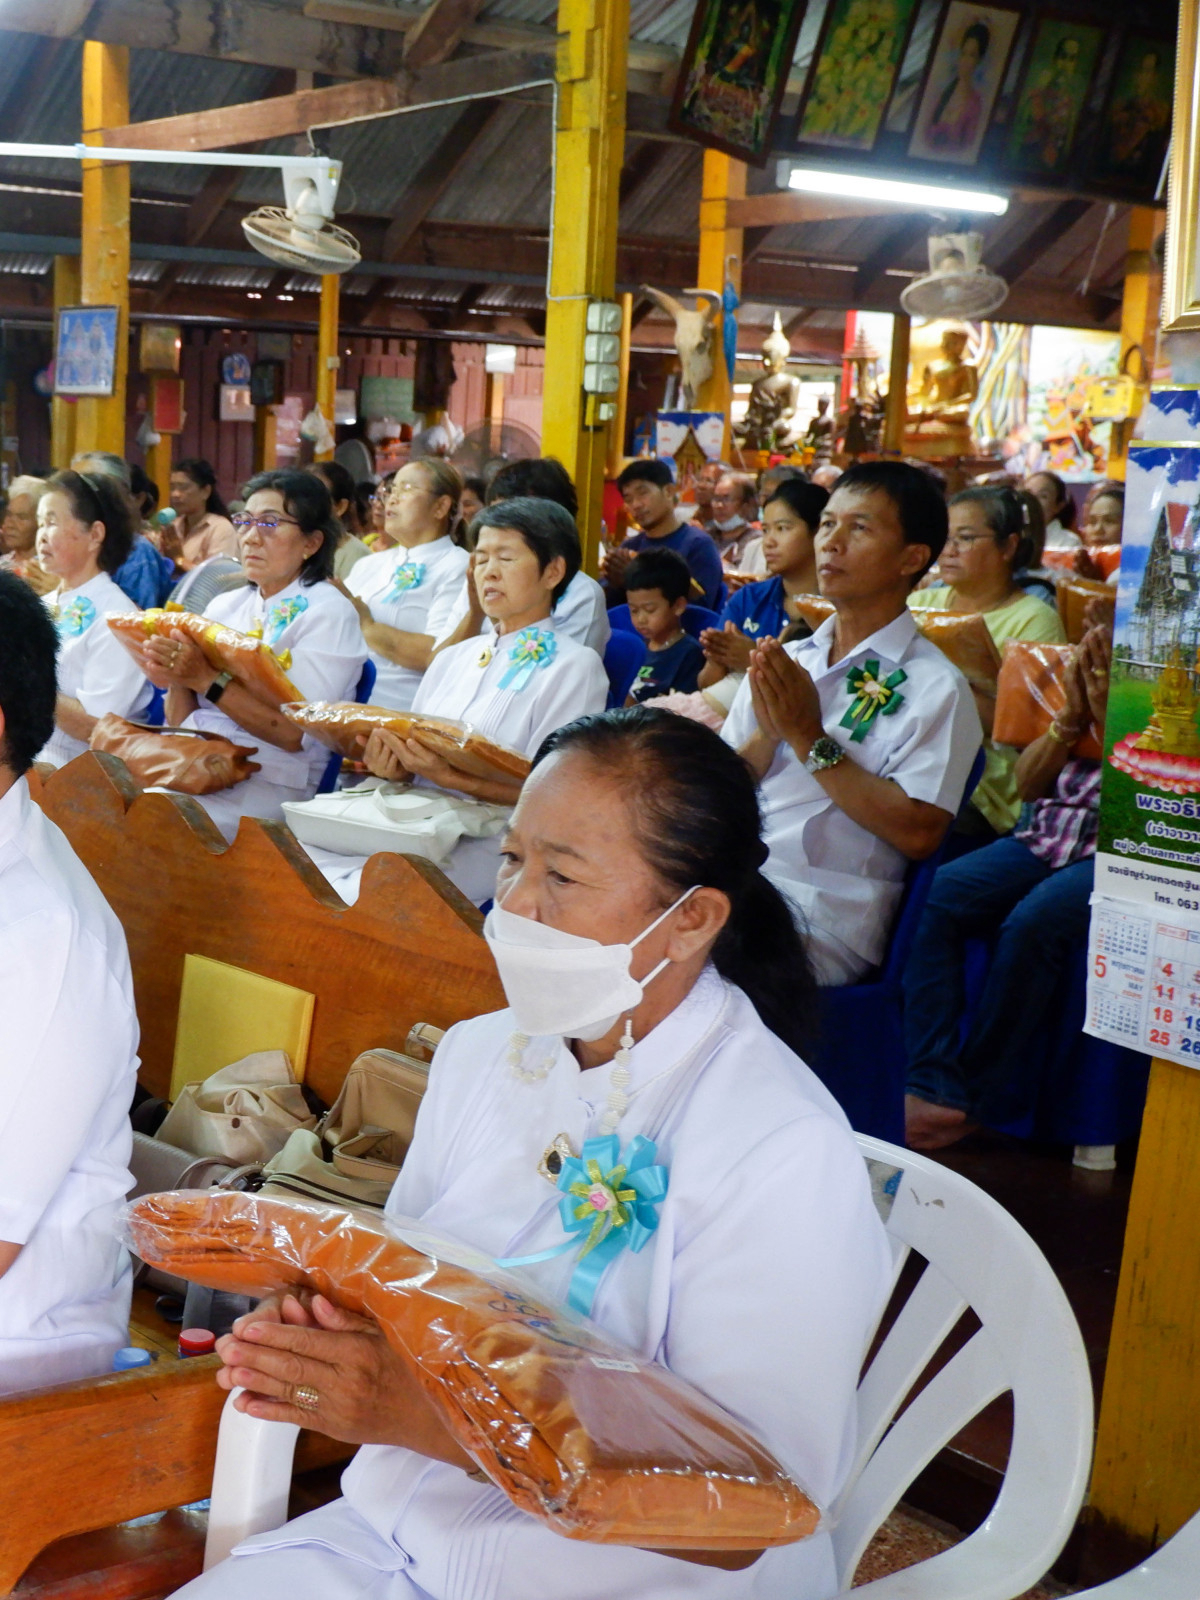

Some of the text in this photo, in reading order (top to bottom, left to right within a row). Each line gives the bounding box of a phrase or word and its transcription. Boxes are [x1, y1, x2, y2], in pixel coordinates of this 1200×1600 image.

[1137, 794, 1200, 817] พระอธิ
[1146, 821, 1200, 841] (เจ้าอาวา
[1177, 898, 1199, 911] 063
[1094, 954, 1107, 978] 5
[1161, 963, 1173, 977] 4
[1153, 984, 1174, 1000] 11
[1153, 1006, 1173, 1023] 18
[1149, 1028, 1171, 1046] 25
[1180, 1037, 1200, 1055] 26
